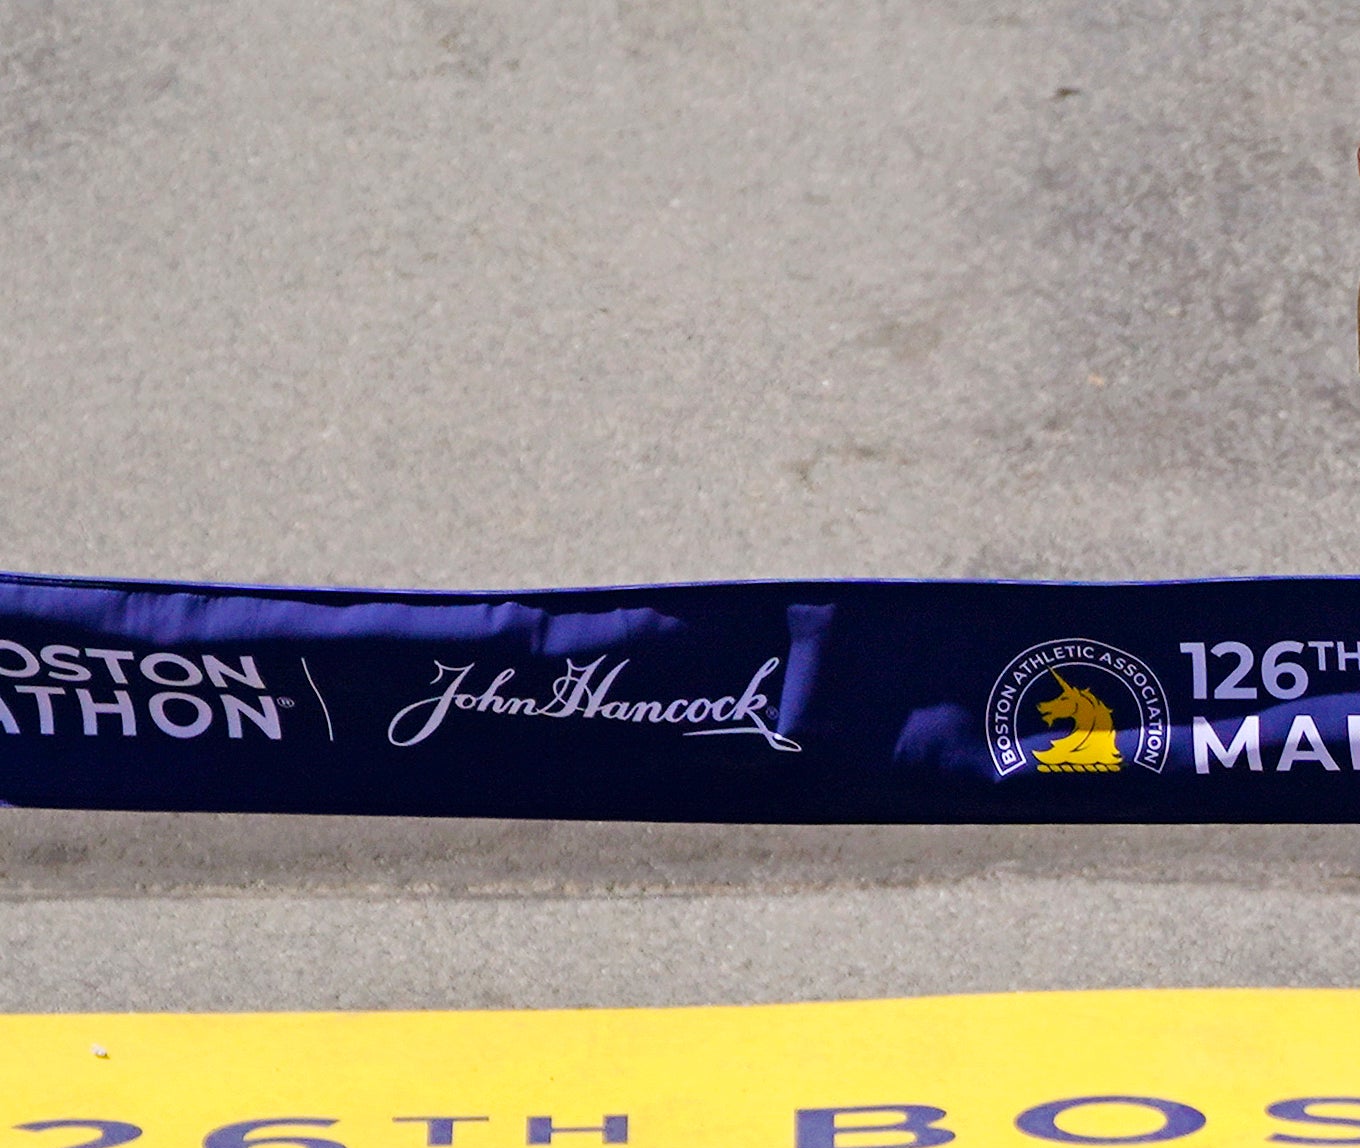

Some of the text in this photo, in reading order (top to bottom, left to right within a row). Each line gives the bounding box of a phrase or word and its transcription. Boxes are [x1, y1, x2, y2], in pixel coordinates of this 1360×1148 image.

[0, 639, 266, 688] OSTON
[387, 659, 542, 747] John
[994, 645, 1164, 766] BOSTON ATHLETIC ASSOCIATION
